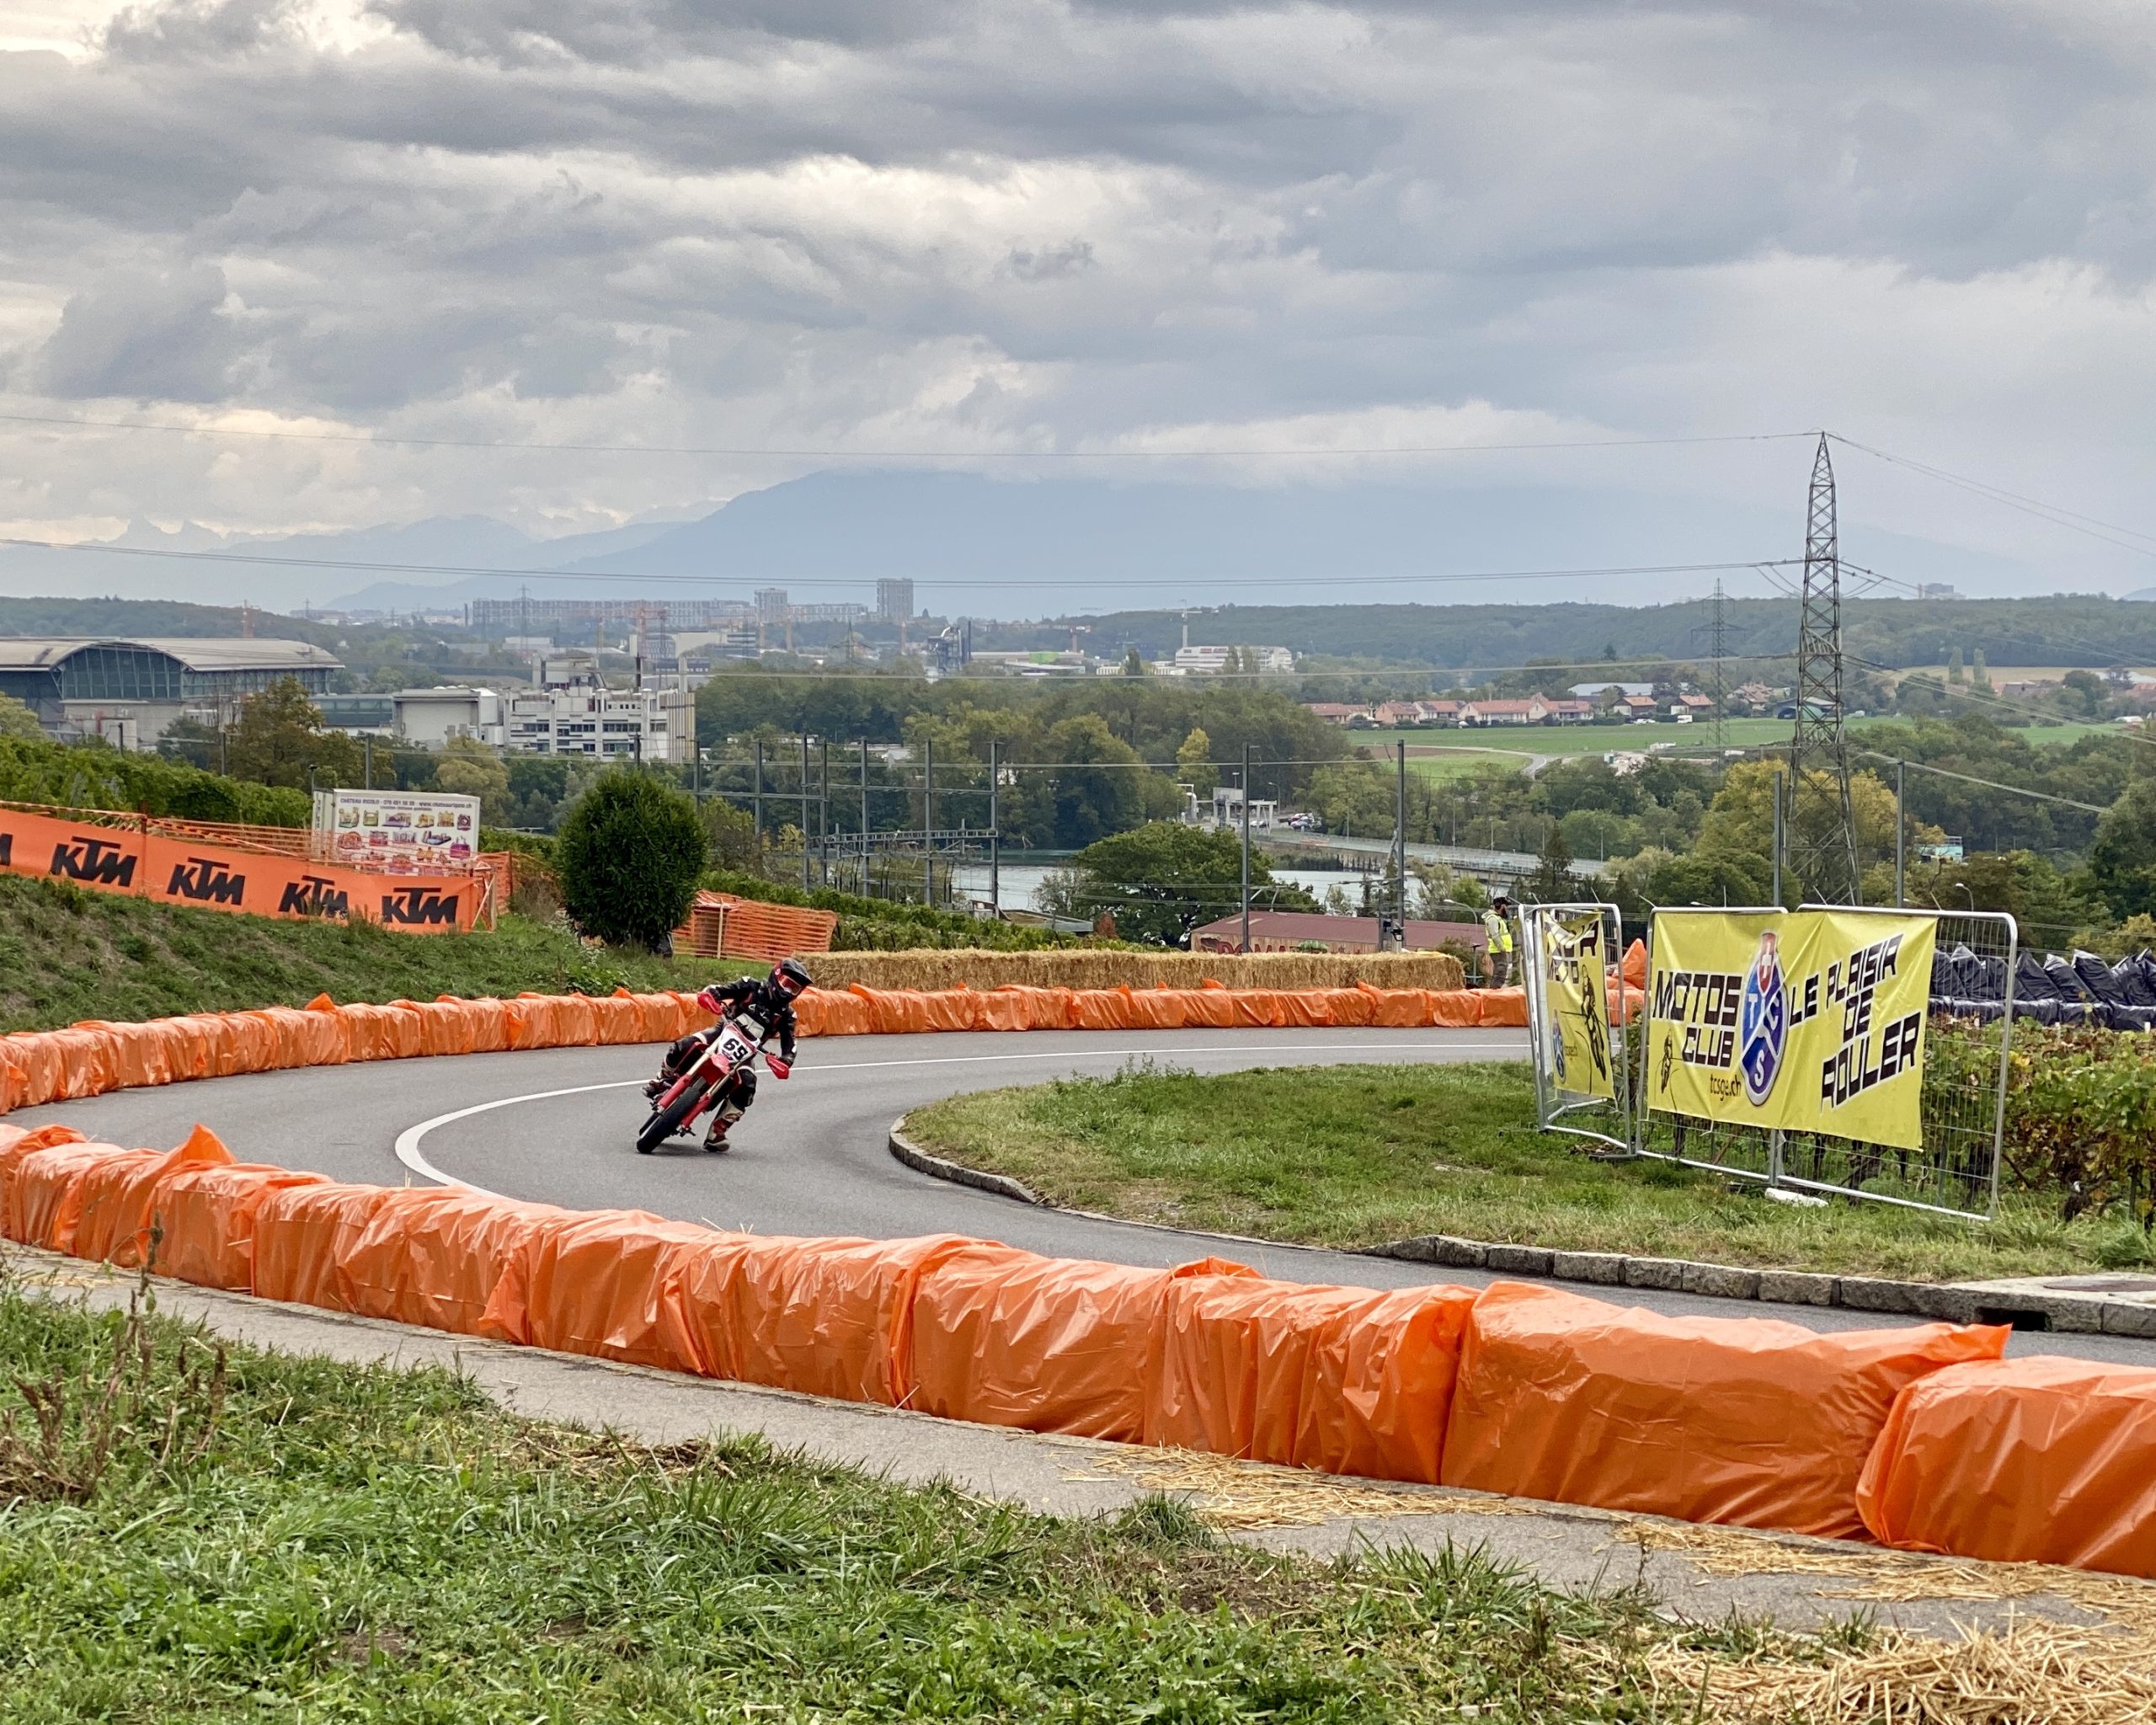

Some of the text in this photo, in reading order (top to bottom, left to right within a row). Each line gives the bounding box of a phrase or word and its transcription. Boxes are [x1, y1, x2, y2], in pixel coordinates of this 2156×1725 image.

[51, 836, 137, 887] KTM
[167, 857, 245, 905] KTM
[278, 874, 348, 920] KTM
[382, 888, 459, 923] KTM
[1652, 970, 1742, 1027] MOTOS
[1789, 933, 1903, 1027] LE PLAISIR
[1843, 987, 1874, 1044] DE
[723, 1038, 749, 1060] 69
[1683, 1027, 1735, 1068] CLUB
[1820, 1012, 1921, 1113] ROULER
[1710, 1074, 1742, 1102] tcsge.ch
